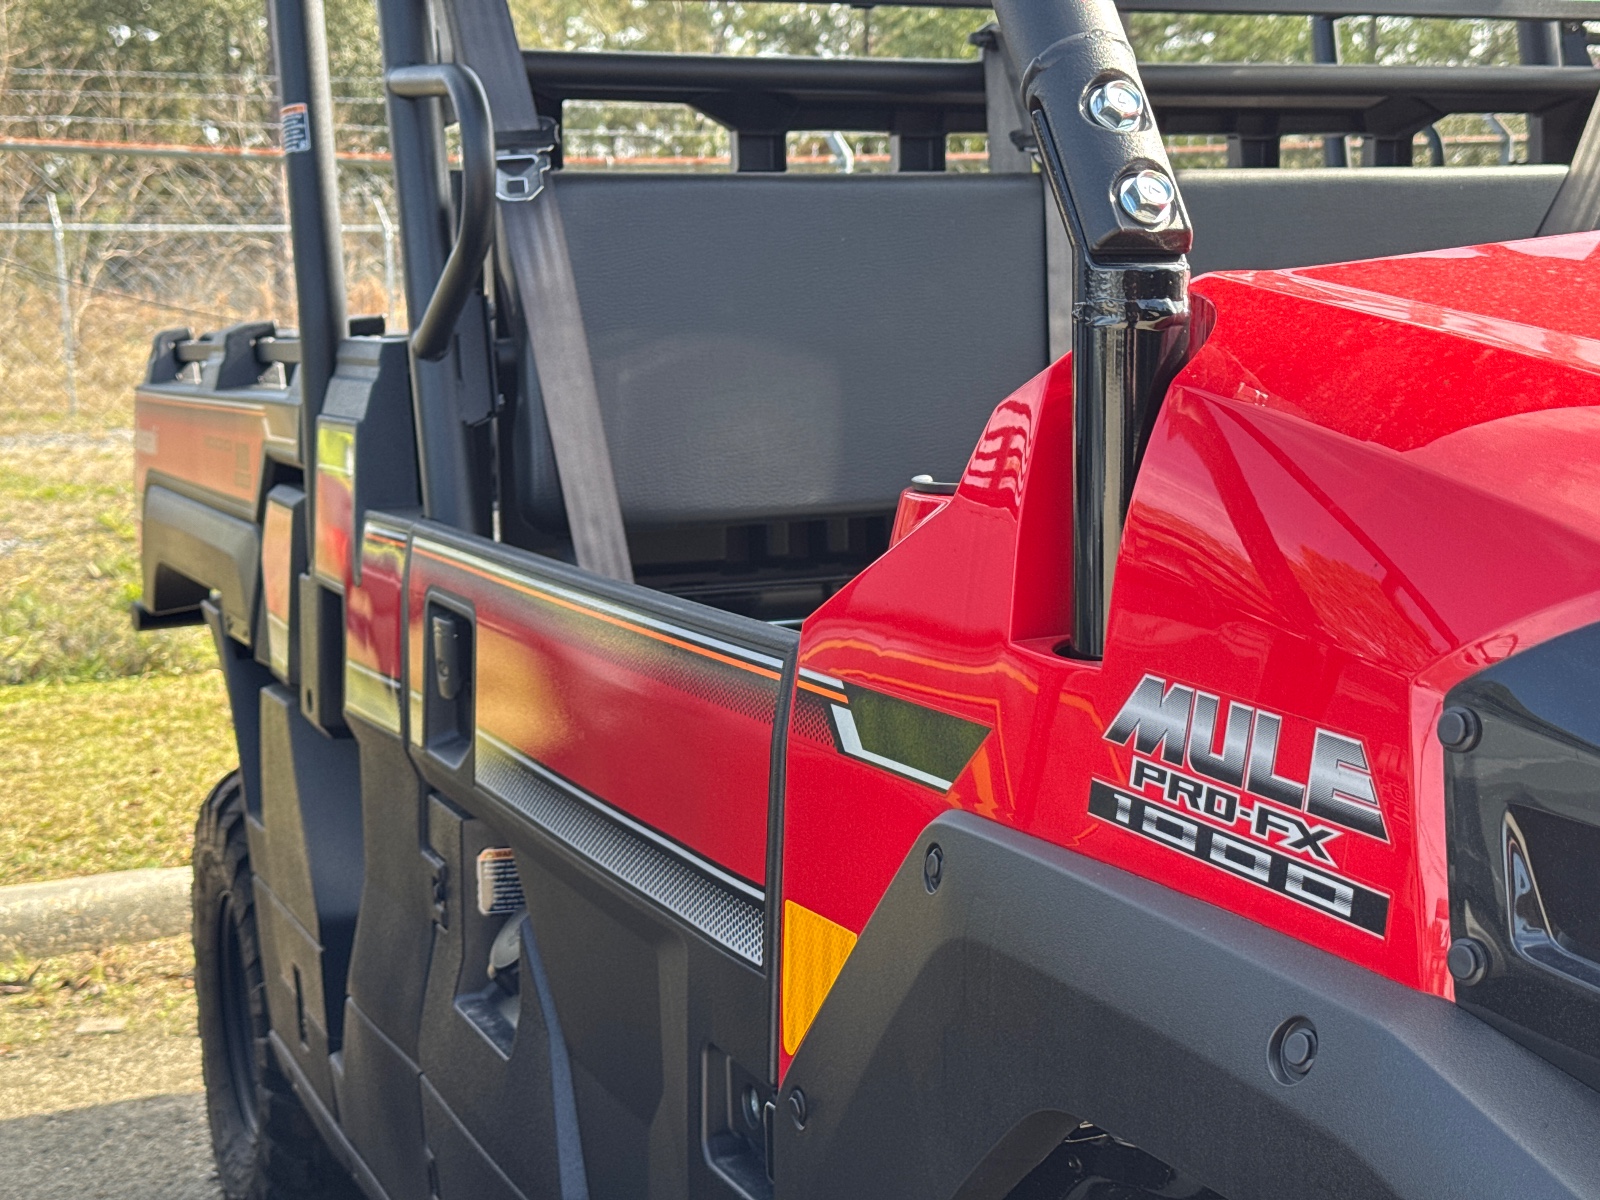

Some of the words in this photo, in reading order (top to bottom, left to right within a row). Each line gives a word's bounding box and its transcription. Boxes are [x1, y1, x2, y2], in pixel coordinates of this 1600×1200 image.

[1102, 673, 1391, 845] MULE
[1129, 755, 1346, 869] PRO-FX
[1113, 793, 1354, 918] 1000
